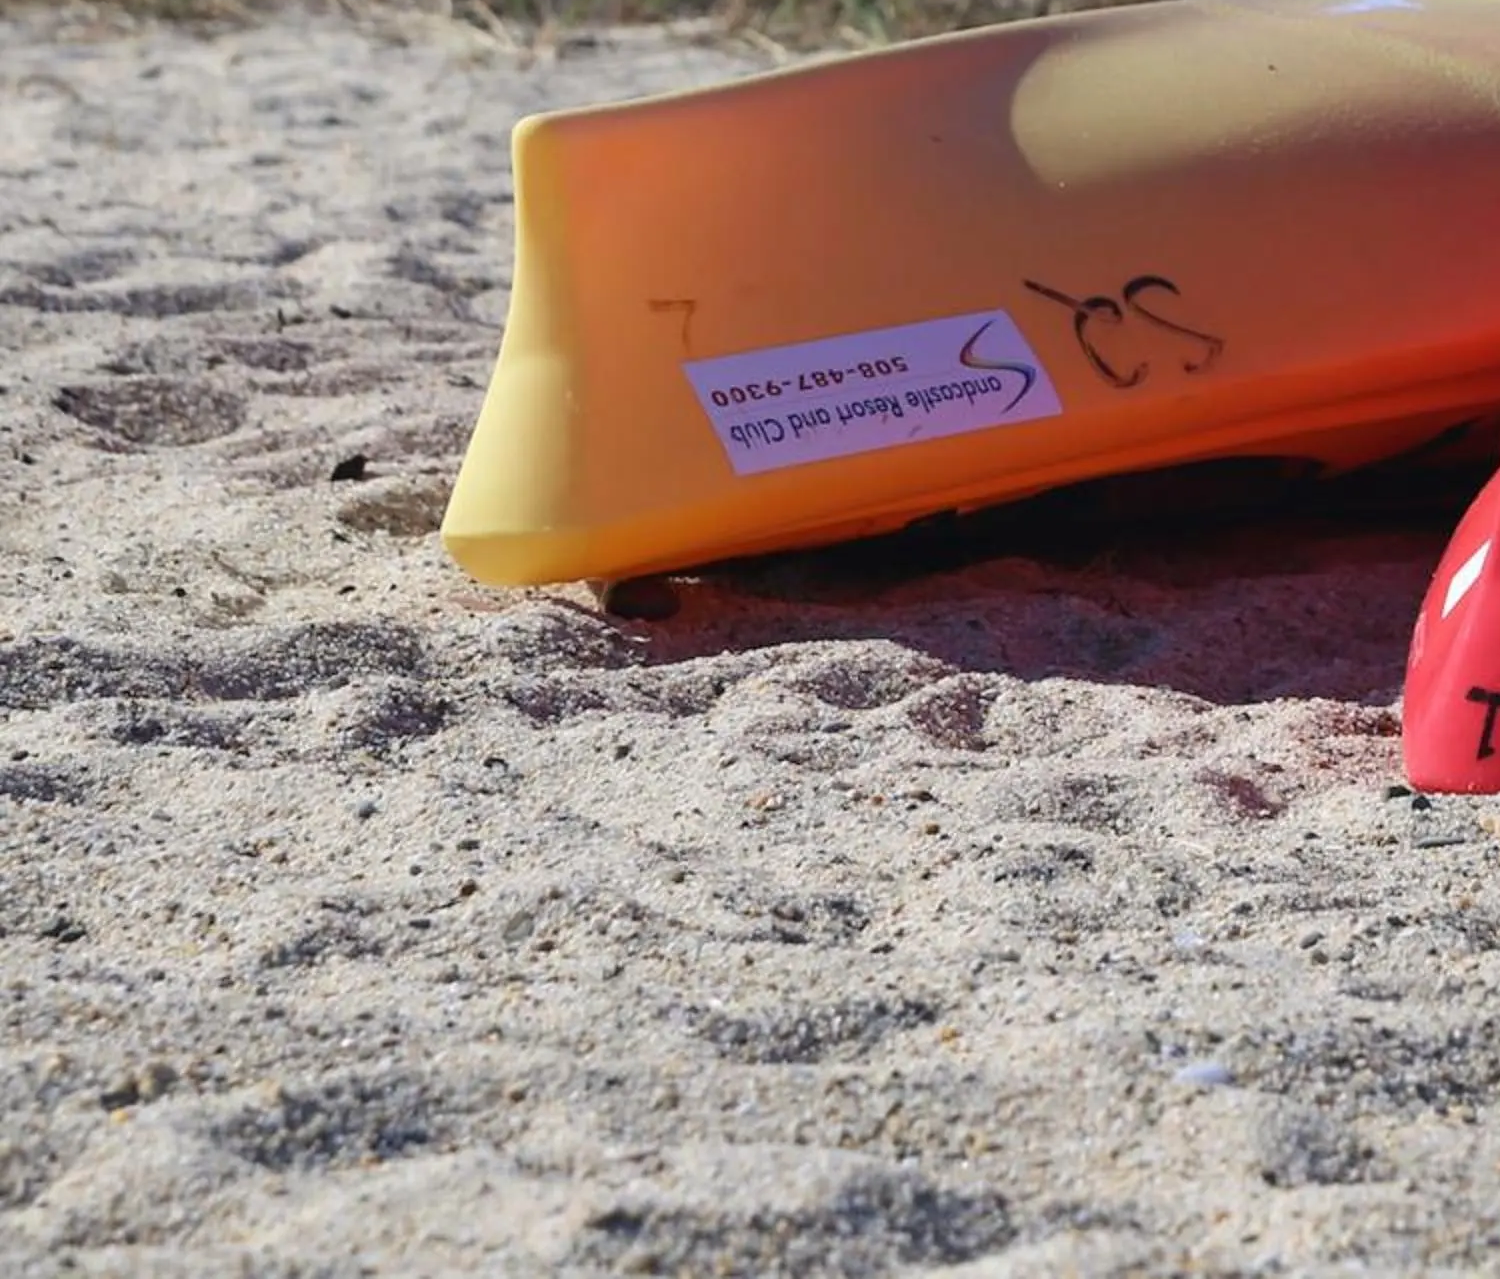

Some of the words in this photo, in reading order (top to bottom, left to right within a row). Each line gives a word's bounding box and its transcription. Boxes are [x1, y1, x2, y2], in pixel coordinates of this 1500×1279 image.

[710, 356, 909, 407] 508-487-9300
[904, 318, 1037, 415] Sandcastle
[786, 407, 832, 439] and
[835, 394, 904, 426] Resort
[729, 418, 785, 450] Club
